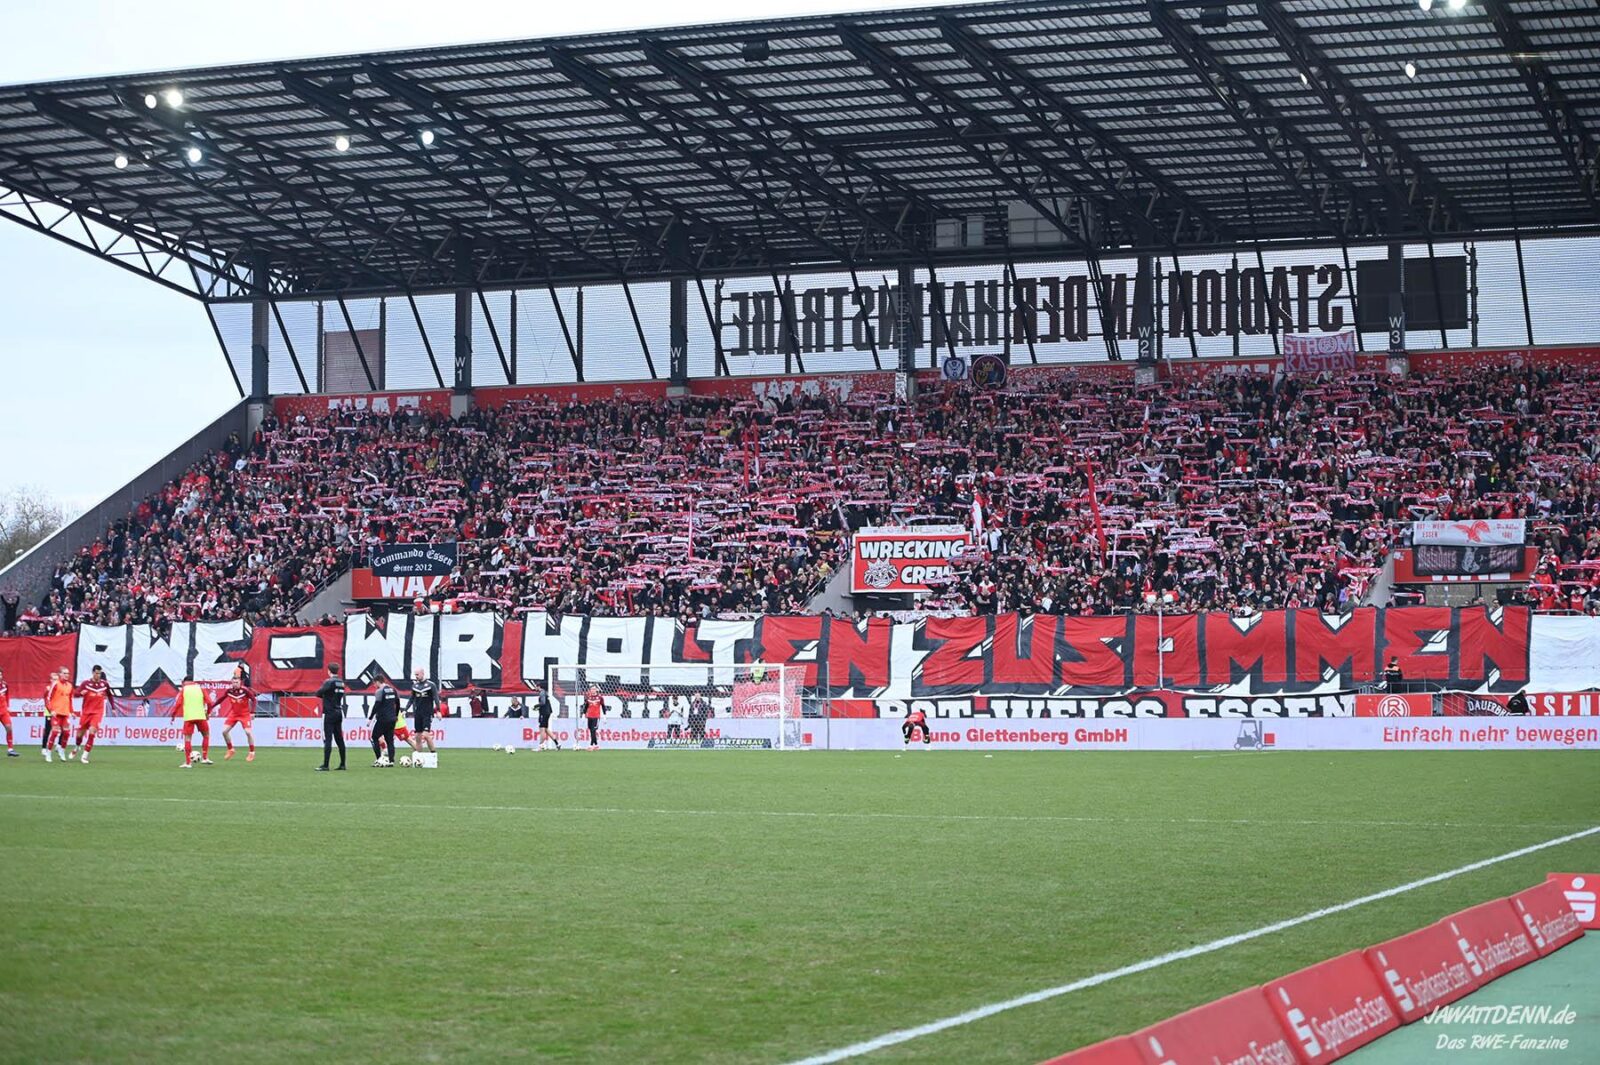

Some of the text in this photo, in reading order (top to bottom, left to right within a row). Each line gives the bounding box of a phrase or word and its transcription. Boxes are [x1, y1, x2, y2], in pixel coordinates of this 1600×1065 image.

[1138, 327, 1151, 353] W 2
[1389, 317, 1402, 345] W 3
[671, 347, 681, 358] W
[455, 357, 465, 368] W
[1285, 353, 1356, 372] KASTEN
[373, 548, 453, 567] Commando Essen
[860, 540, 966, 559] WRECKING
[393, 563, 433, 572] Since 2012
[76, 619, 251, 694] RWE
[344, 611, 502, 690] WIR
[522, 610, 894, 695] HALTEN
[914, 605, 1531, 696] ZUSAMMEN
[124, 726, 184, 742] bewegen
[277, 726, 322, 740] Einfac
[522, 728, 568, 741] Bro
[574, 728, 666, 742] Glttenberg
[911, 728, 1128, 745] Buno Glettenberg GmbH
[1383, 726, 1453, 742] Einfach
[1516, 726, 1598, 745] bewegen
